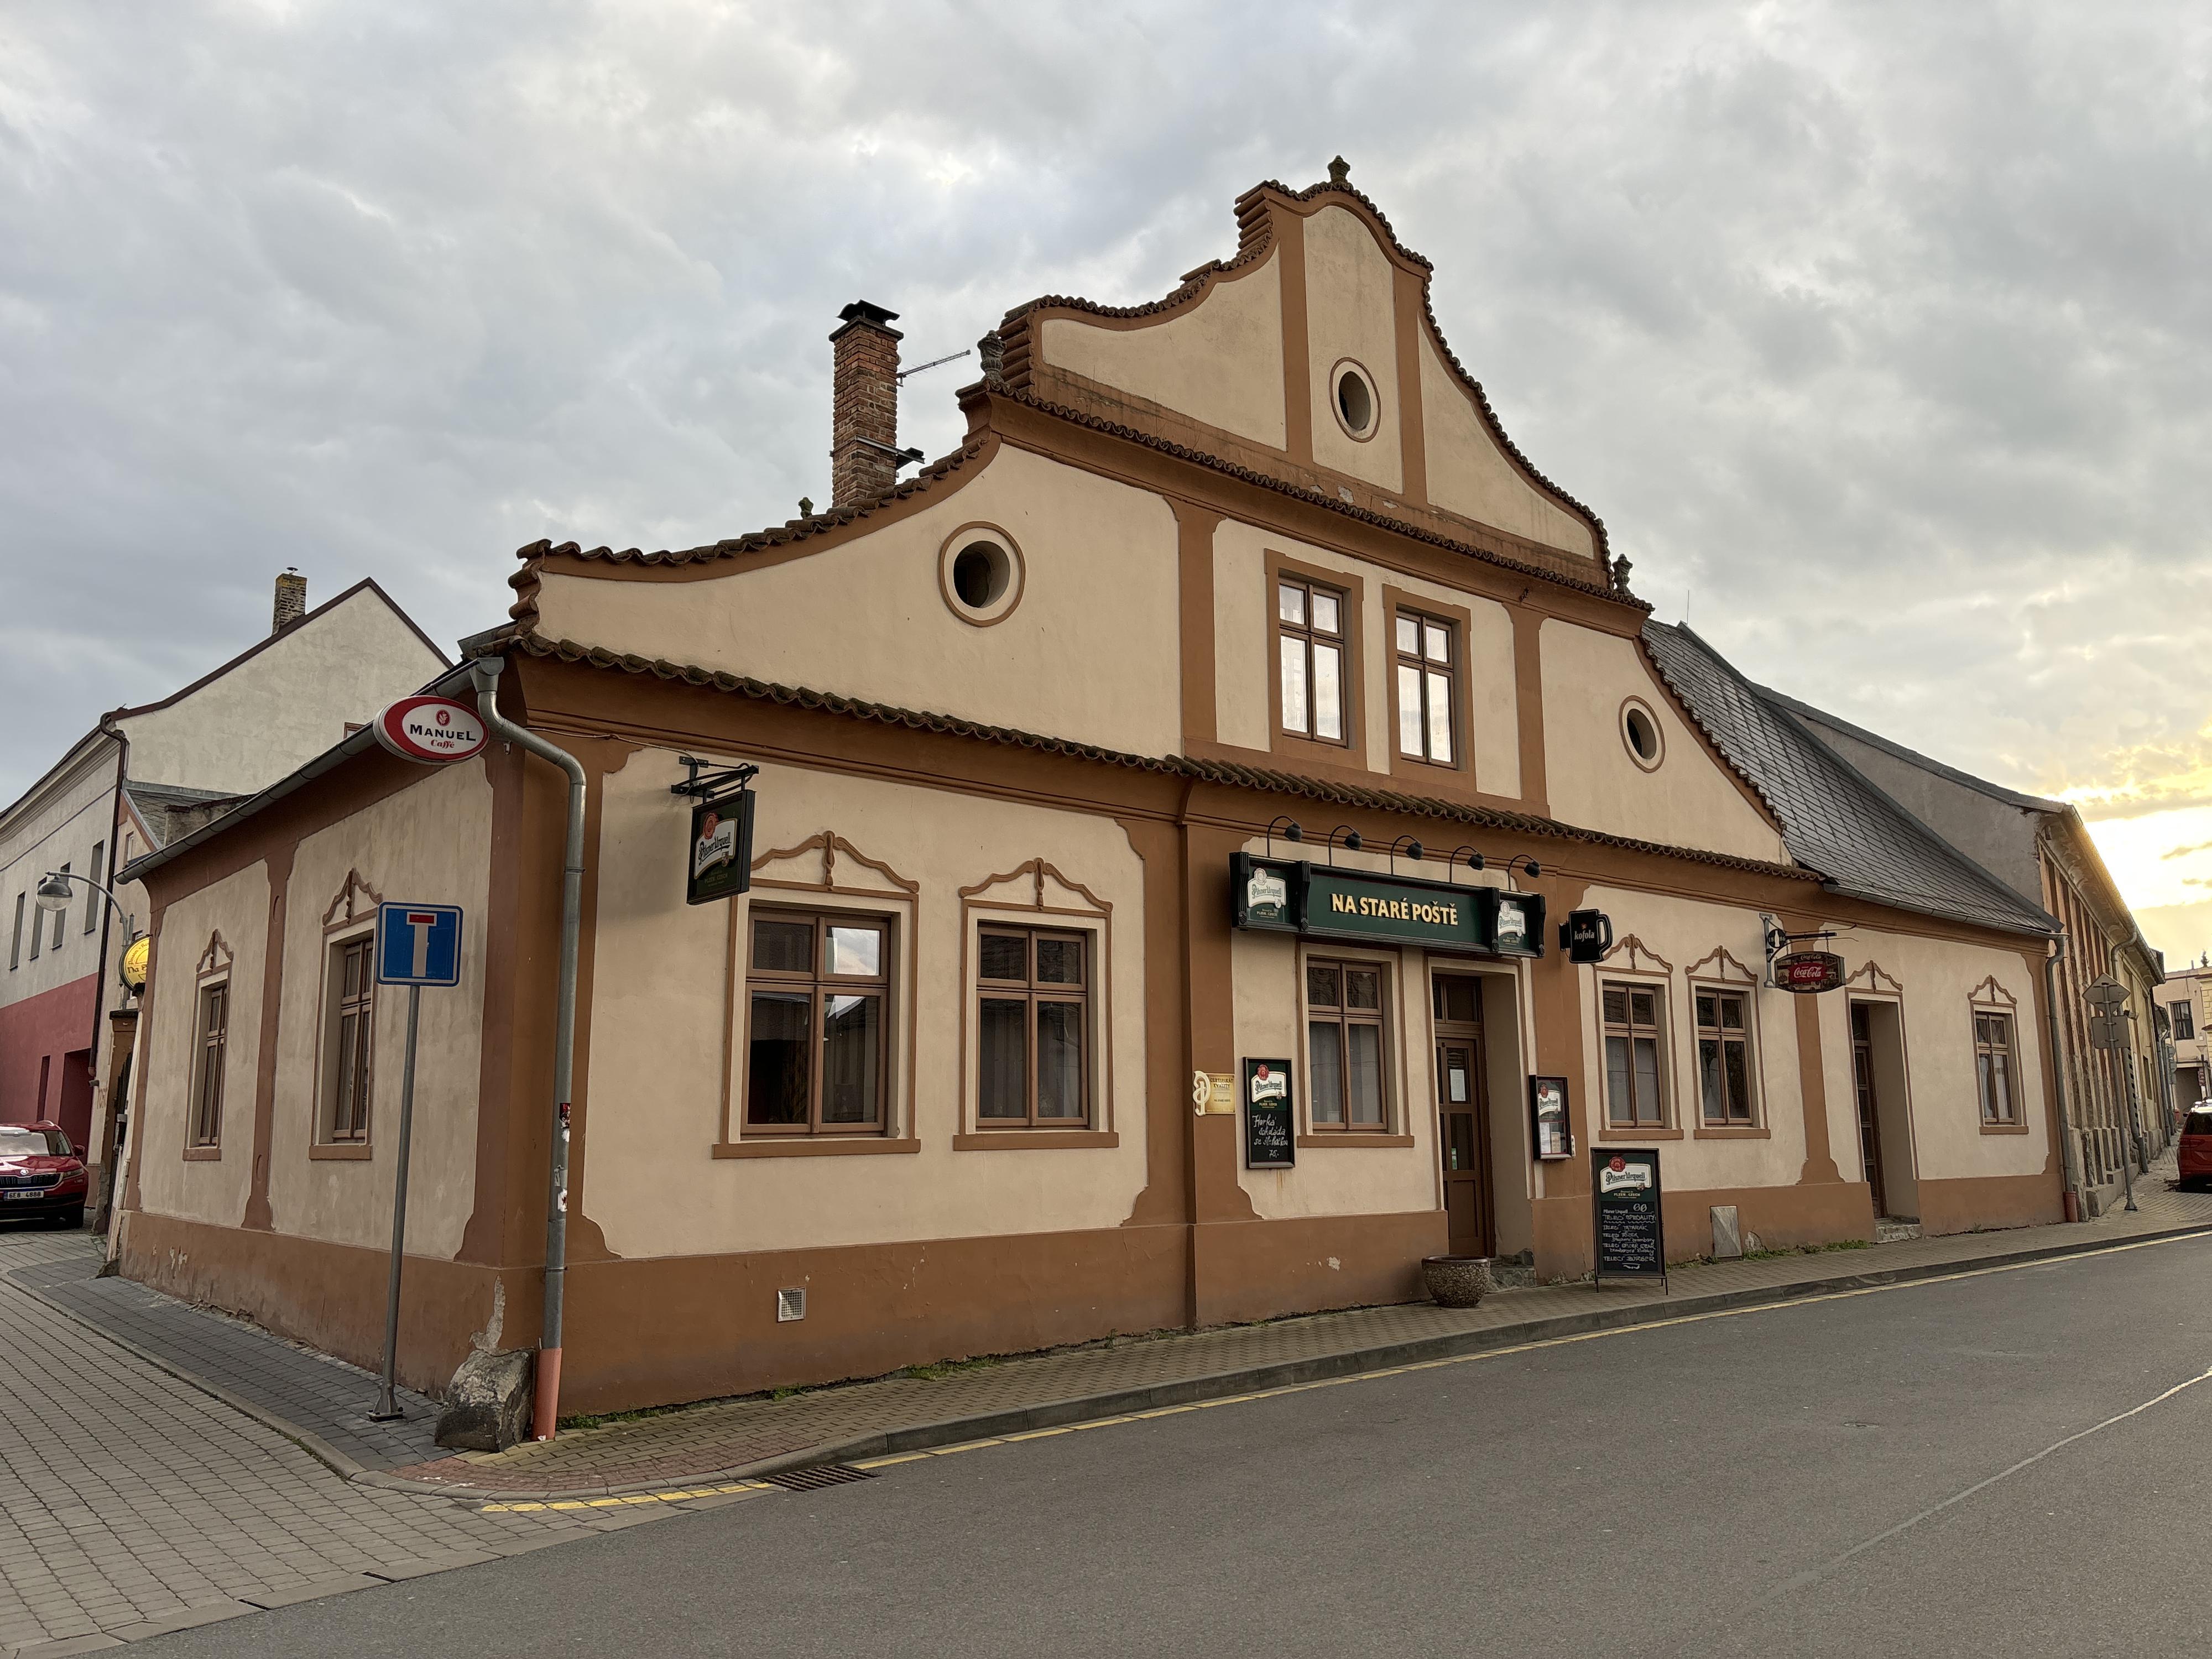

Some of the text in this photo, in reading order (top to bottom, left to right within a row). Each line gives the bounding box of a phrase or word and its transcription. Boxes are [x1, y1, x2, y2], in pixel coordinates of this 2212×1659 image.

[410, 723, 476, 742] MANUEL
[698, 831, 732, 866] Pilsner Urquell
[1251, 884, 1282, 899] Pilsner Urquell
[1331, 893, 1459, 926] NA STARÉ POŠTĚ
[1574, 929, 1595, 942] kofola
[1793, 966, 1823, 978] Coca-Cola
[1255, 1079, 1282, 1094] Pilsner Urquell
[1252, 1113, 1277, 1128] Horká
[1605, 1171, 1646, 1185] Pilsner Urquell
